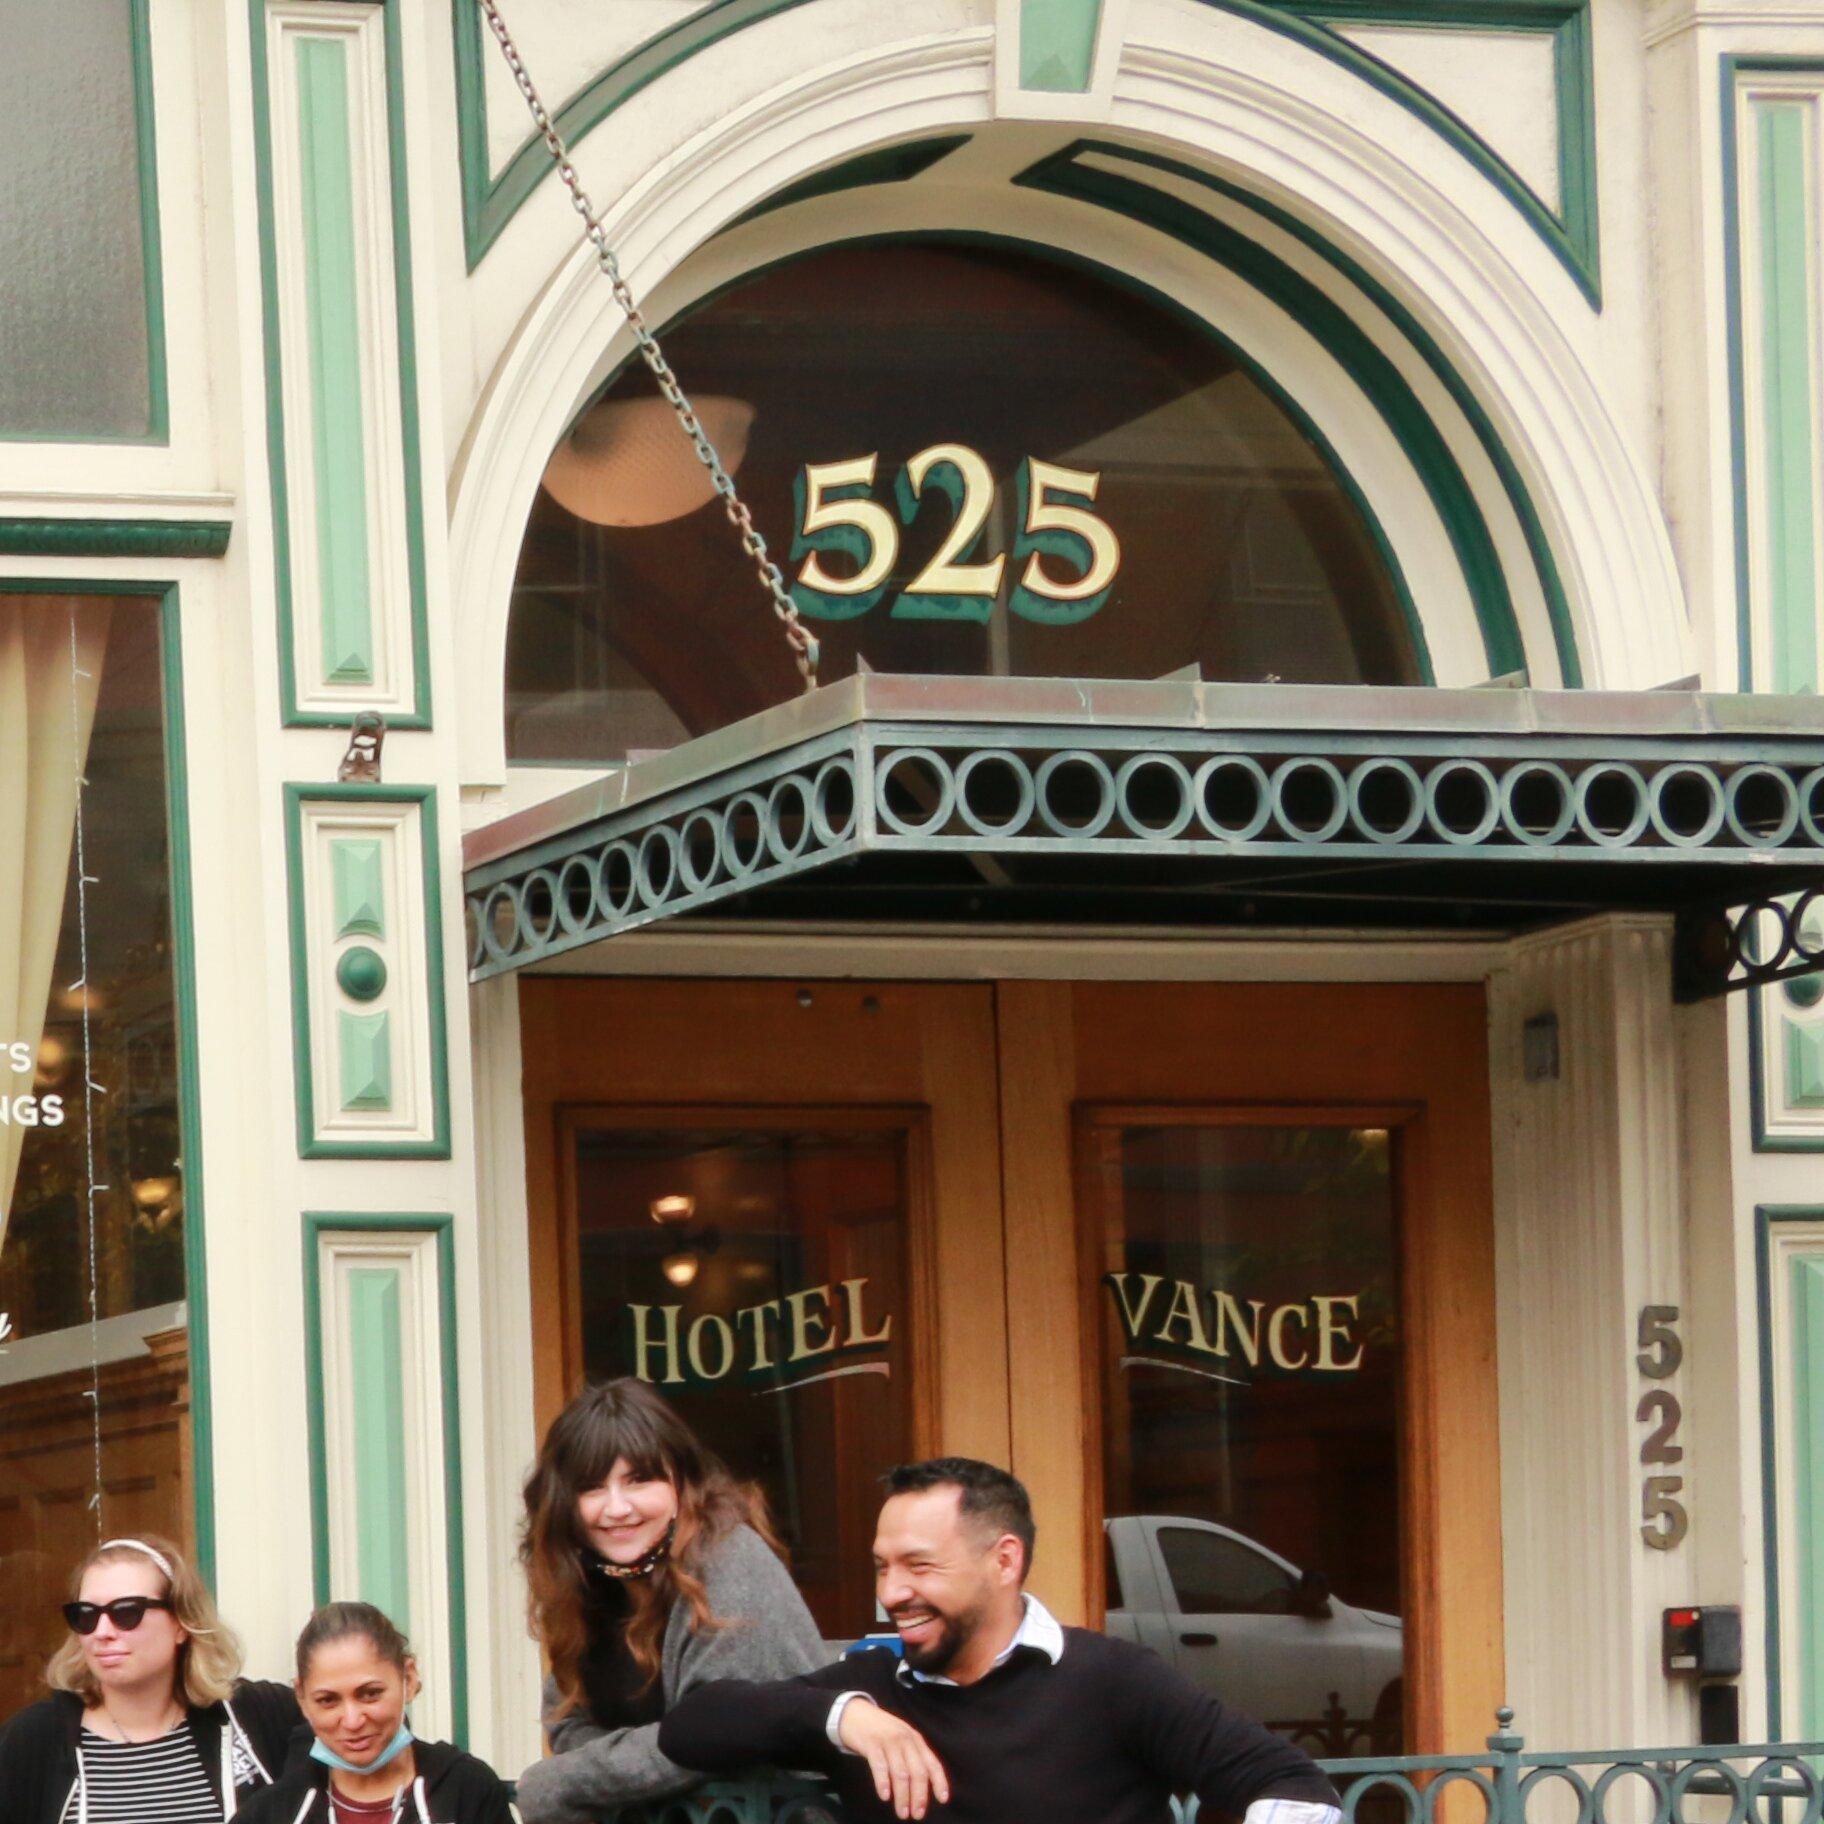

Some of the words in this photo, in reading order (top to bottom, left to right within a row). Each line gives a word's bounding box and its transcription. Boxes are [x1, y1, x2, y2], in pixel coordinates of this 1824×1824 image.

[796, 442, 1122, 604] 525
[626, 1277, 893, 1384] HOTEL
[1109, 1272, 1365, 1371] VANCE
[1635, 1305, 1689, 1551] 525
